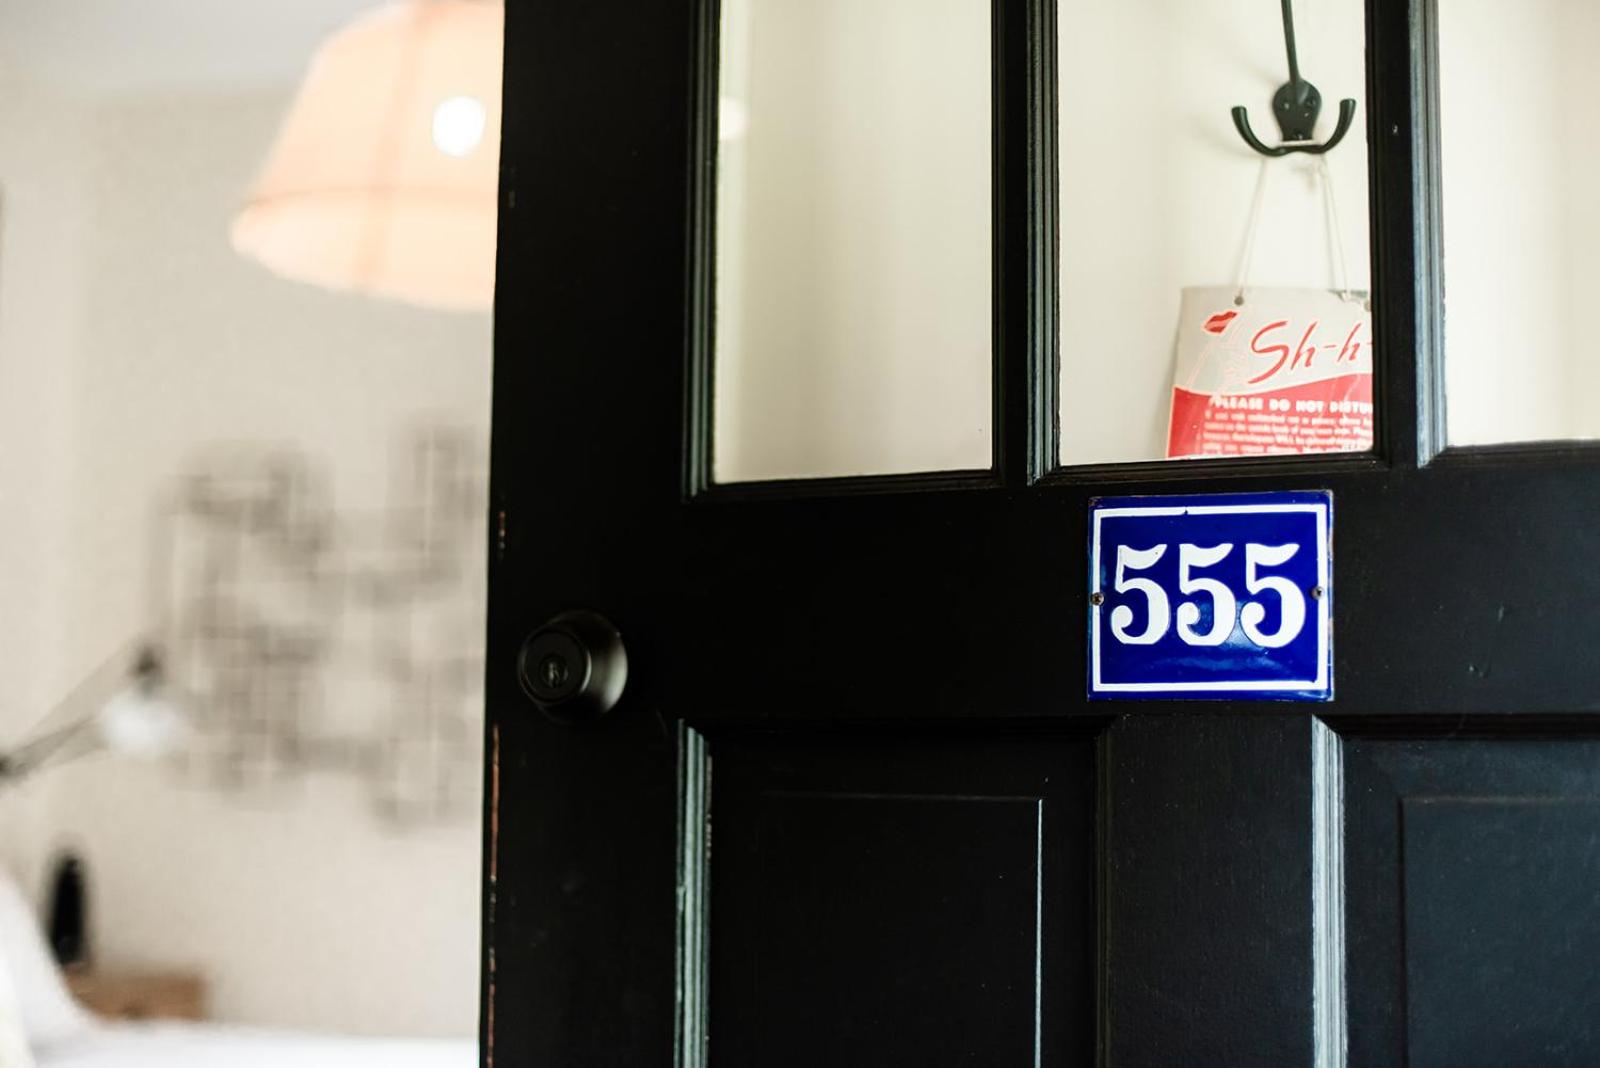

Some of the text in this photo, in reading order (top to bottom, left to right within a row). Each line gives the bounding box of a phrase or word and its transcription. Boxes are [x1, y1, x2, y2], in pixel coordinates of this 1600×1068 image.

[1213, 396, 1264, 410] PLEASE
[1269, 398, 1291, 412] DO
[1295, 399, 1324, 413] NOT
[1110, 542, 1306, 648] 555
